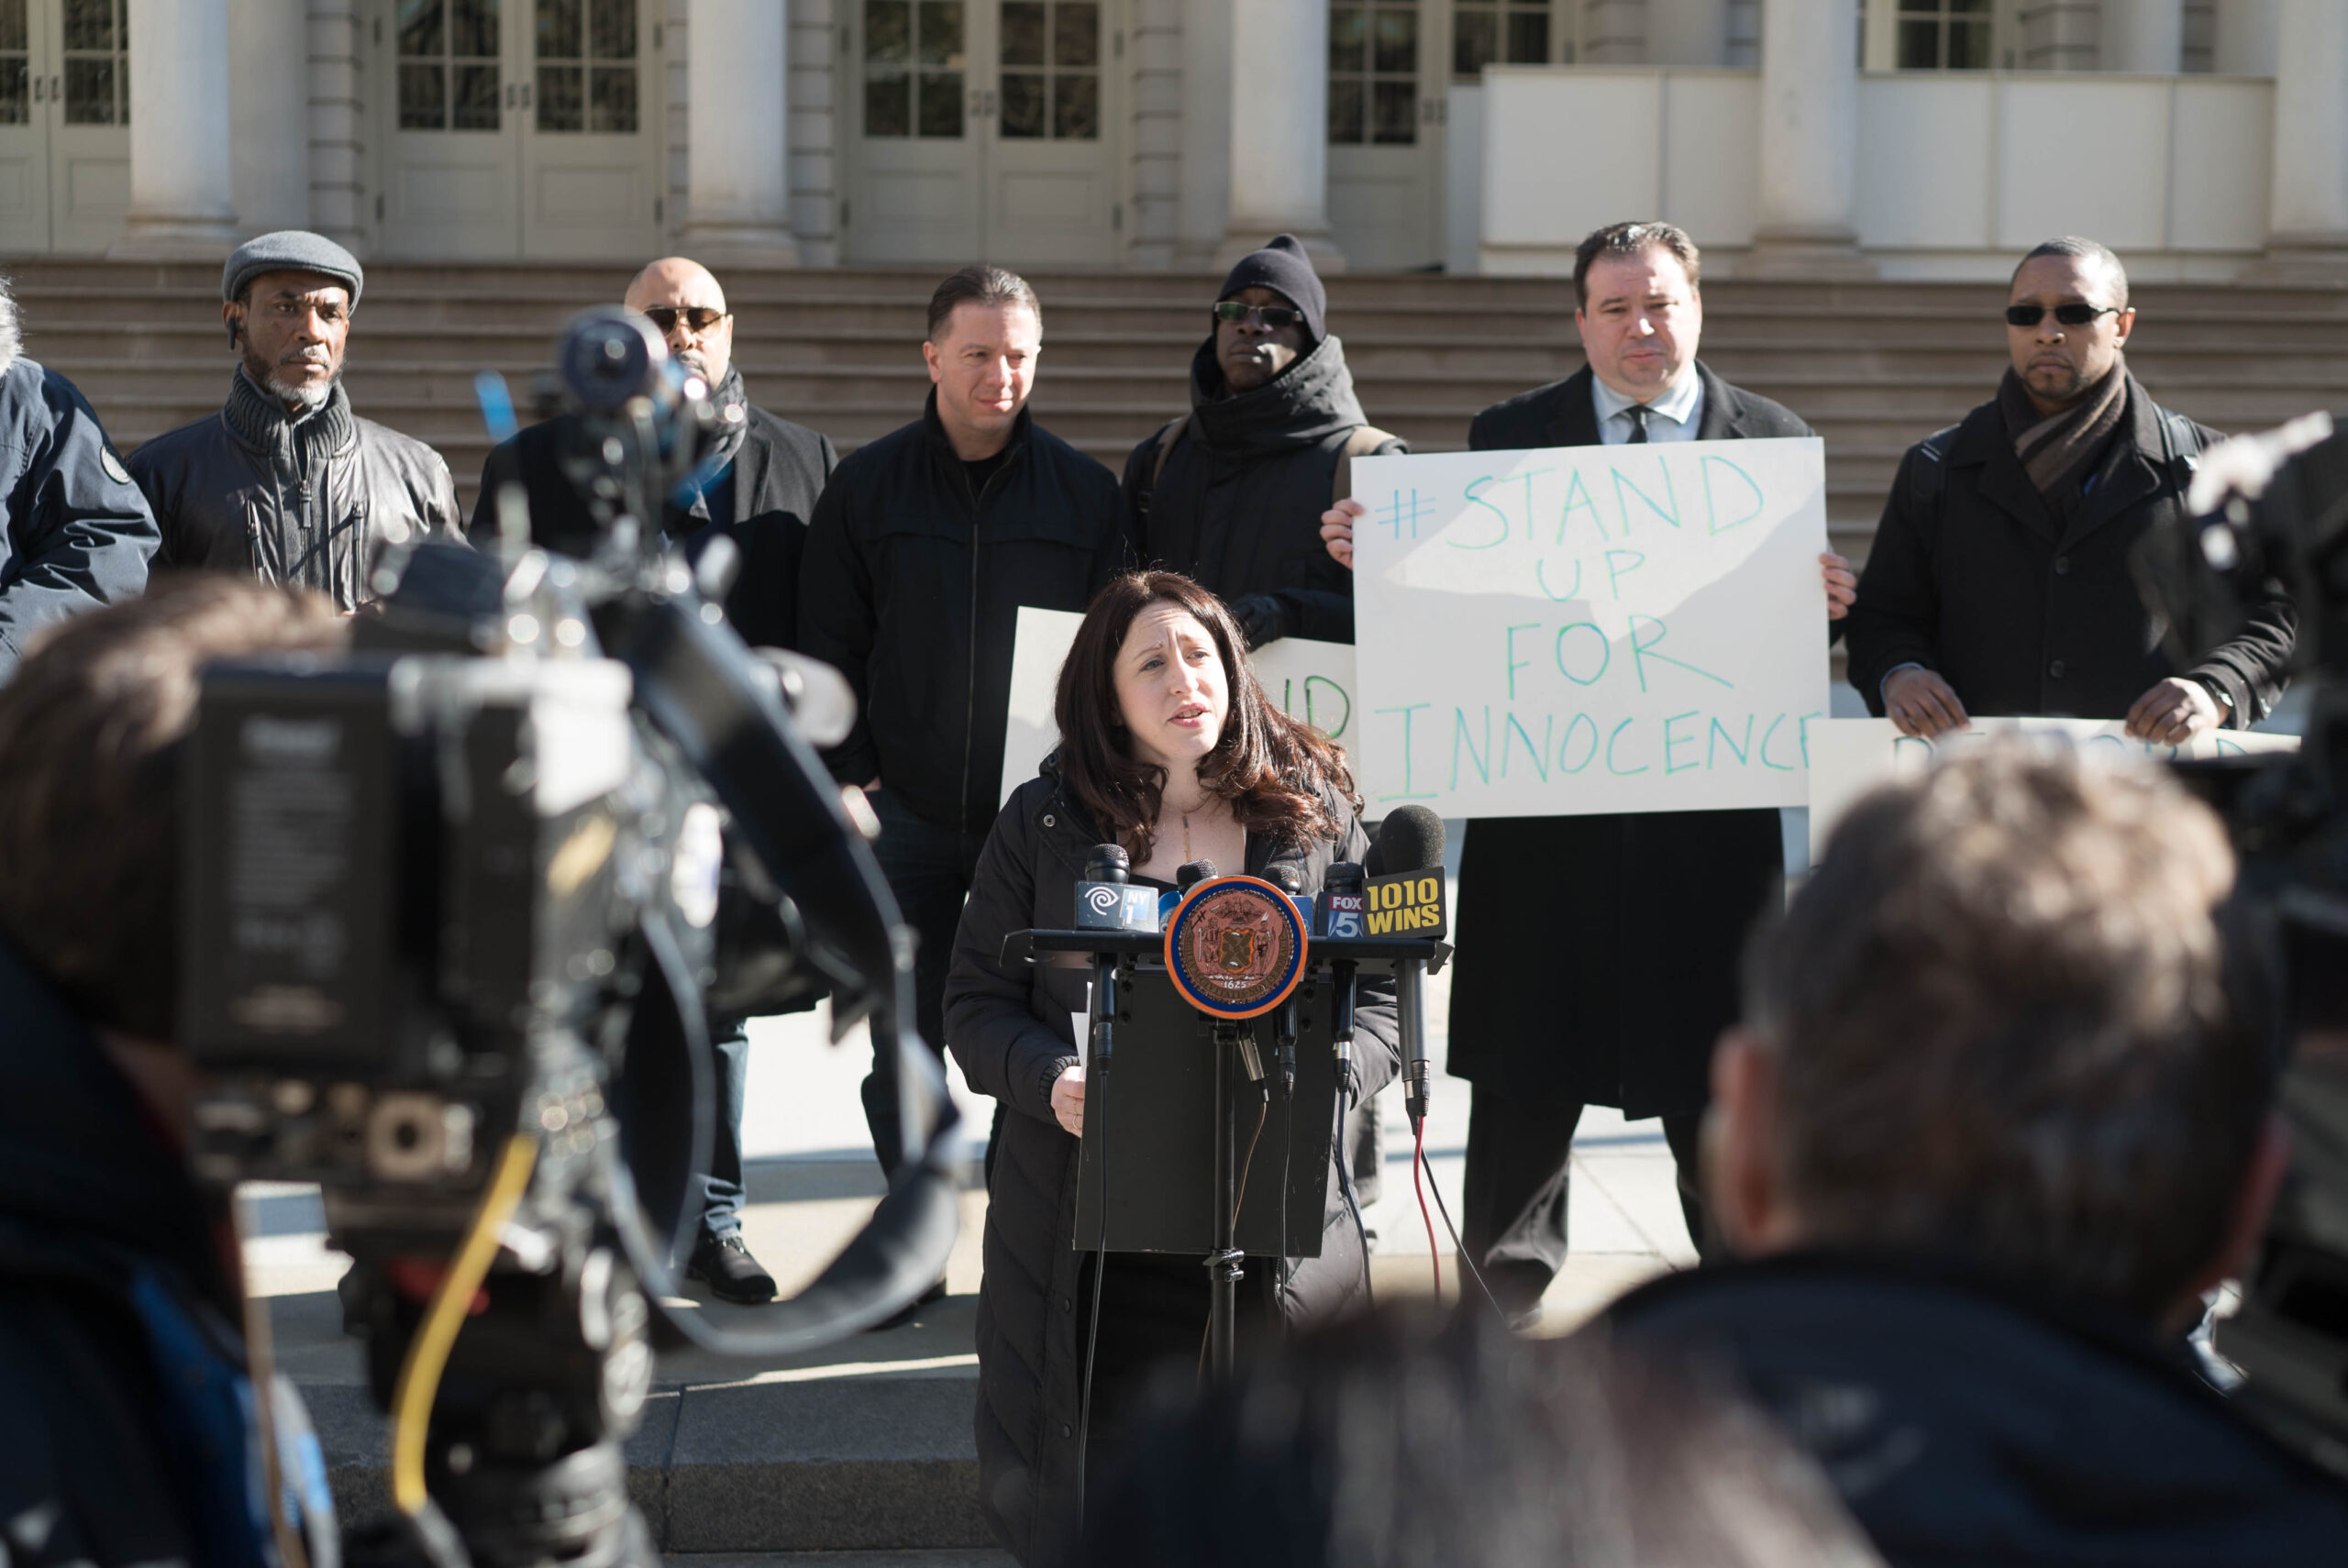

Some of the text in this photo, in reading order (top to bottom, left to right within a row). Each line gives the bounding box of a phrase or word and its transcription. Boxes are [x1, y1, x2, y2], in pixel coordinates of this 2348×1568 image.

[1536, 549, 1645, 602] UP
[1506, 613, 1734, 701] FOR
[1126, 891, 1147, 906] NY
[1333, 896, 1363, 911] FOX
[1367, 878, 1439, 911] 1010
[1125, 905, 1135, 925] 1
[1335, 912, 1359, 939] 5
[1367, 903, 1440, 935] WINS
[1224, 980, 1246, 989] 1625
